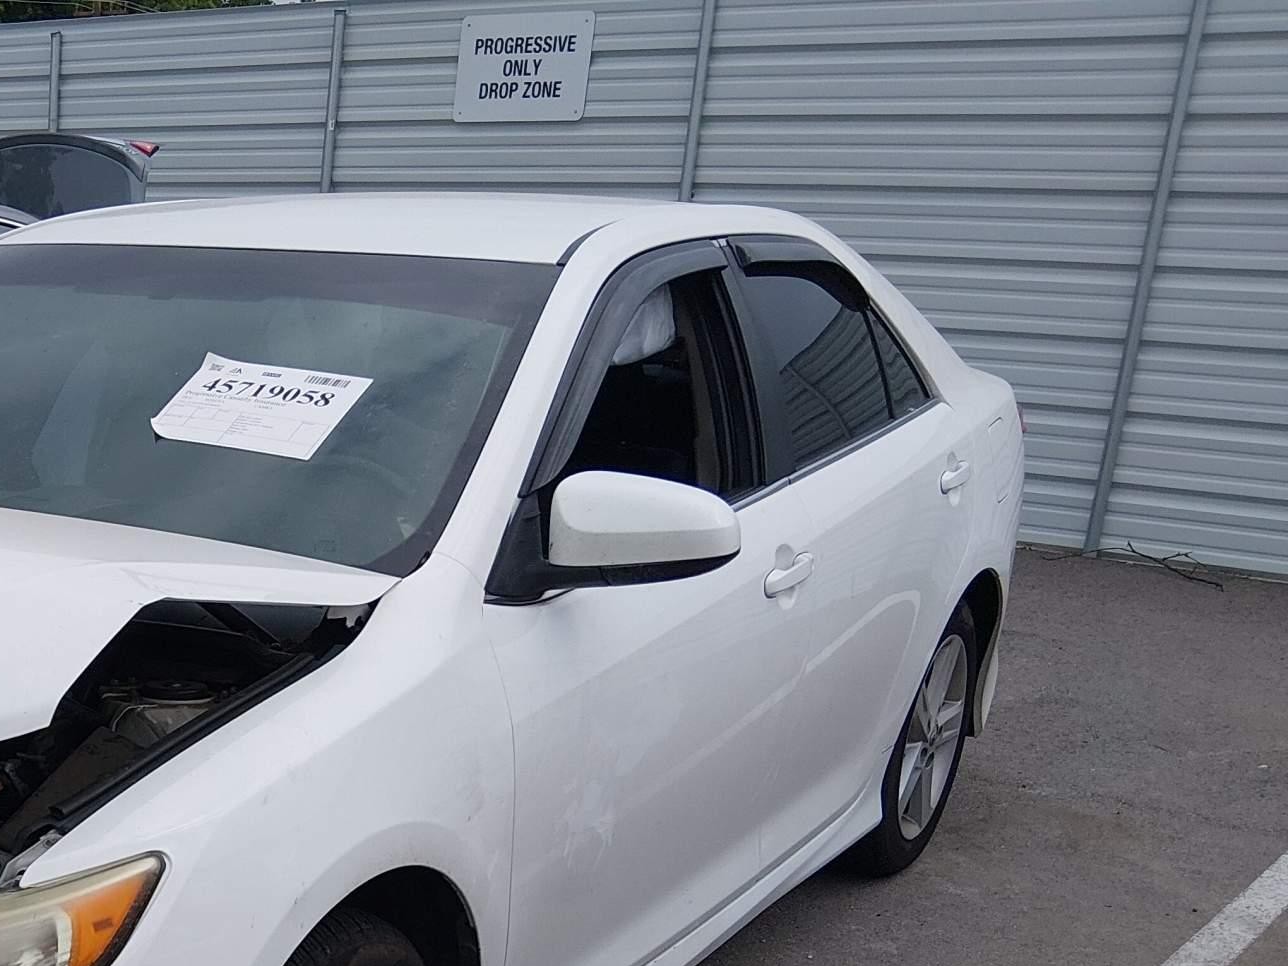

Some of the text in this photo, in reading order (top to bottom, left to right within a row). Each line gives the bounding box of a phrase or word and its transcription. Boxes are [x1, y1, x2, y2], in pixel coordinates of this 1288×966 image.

[474, 35, 577, 56] PROGRESSIVE
[502, 59, 542, 77] ONLY
[478, 81, 562, 100] DROP ZONE
[201, 377, 336, 408] 45719058
